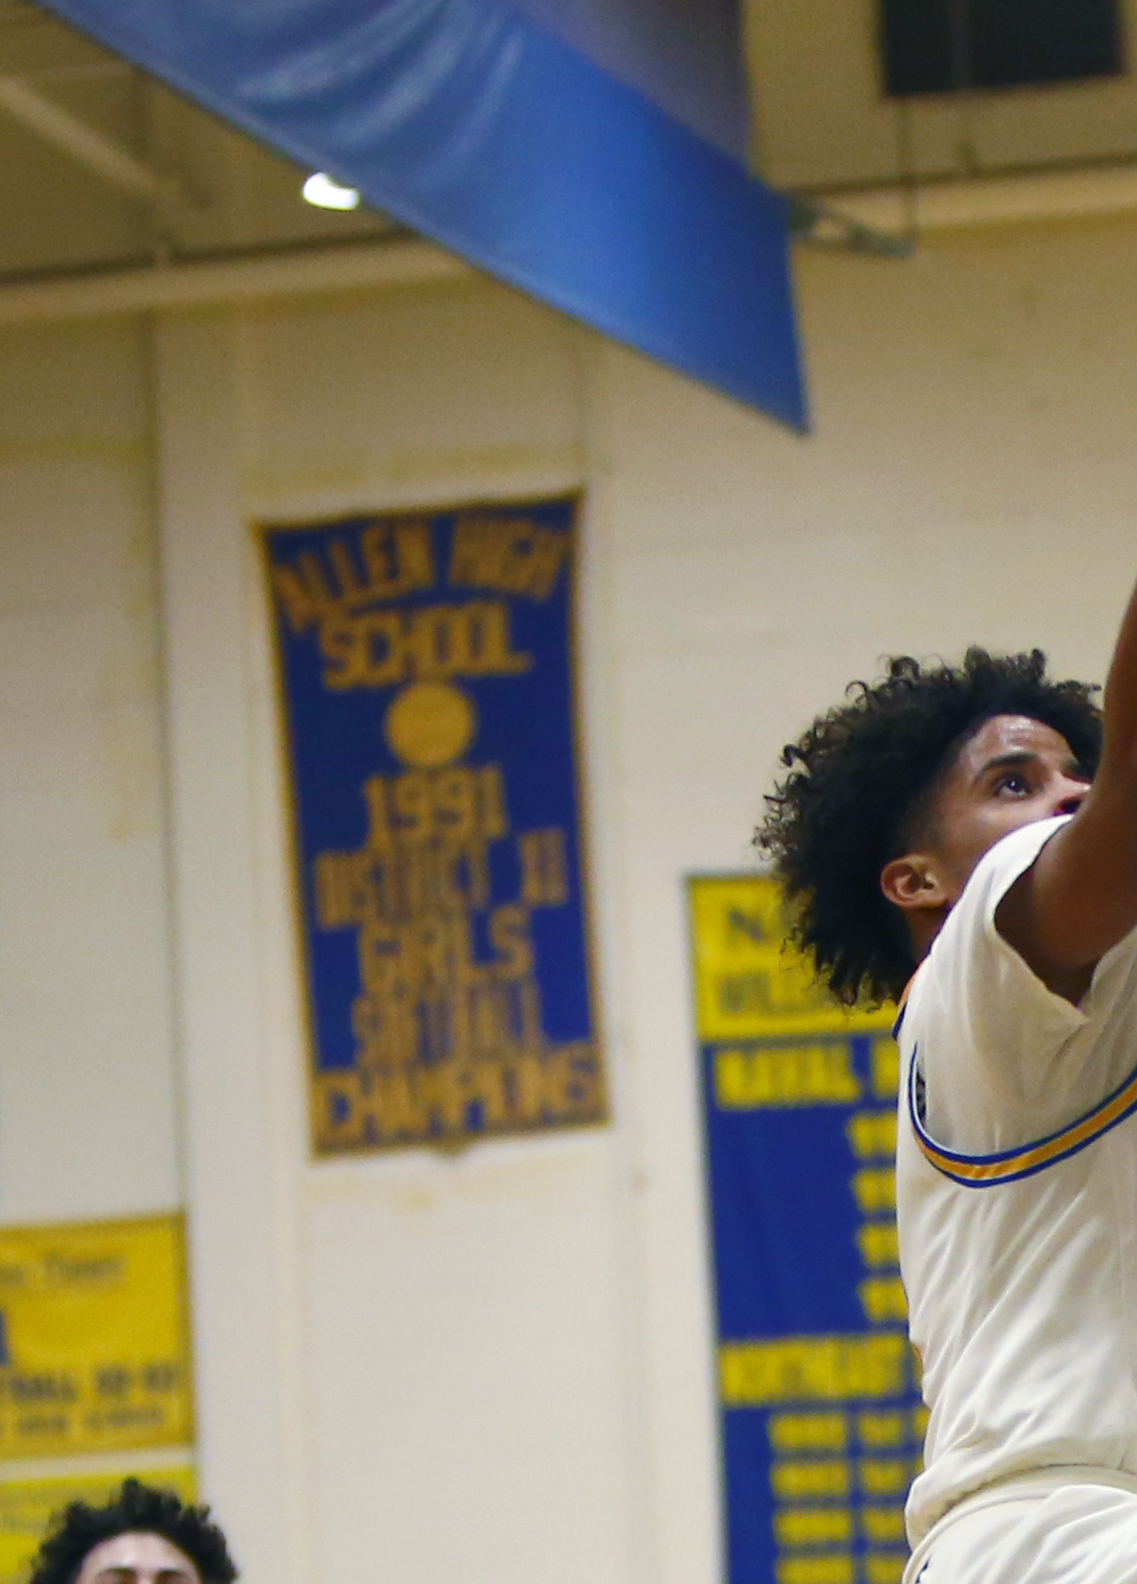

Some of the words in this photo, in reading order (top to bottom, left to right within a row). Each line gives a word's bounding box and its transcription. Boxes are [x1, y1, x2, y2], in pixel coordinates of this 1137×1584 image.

[270, 516, 432, 632] ALLEN
[321, 602, 535, 690] SCHOOL
[363, 764, 509, 848] 1991
